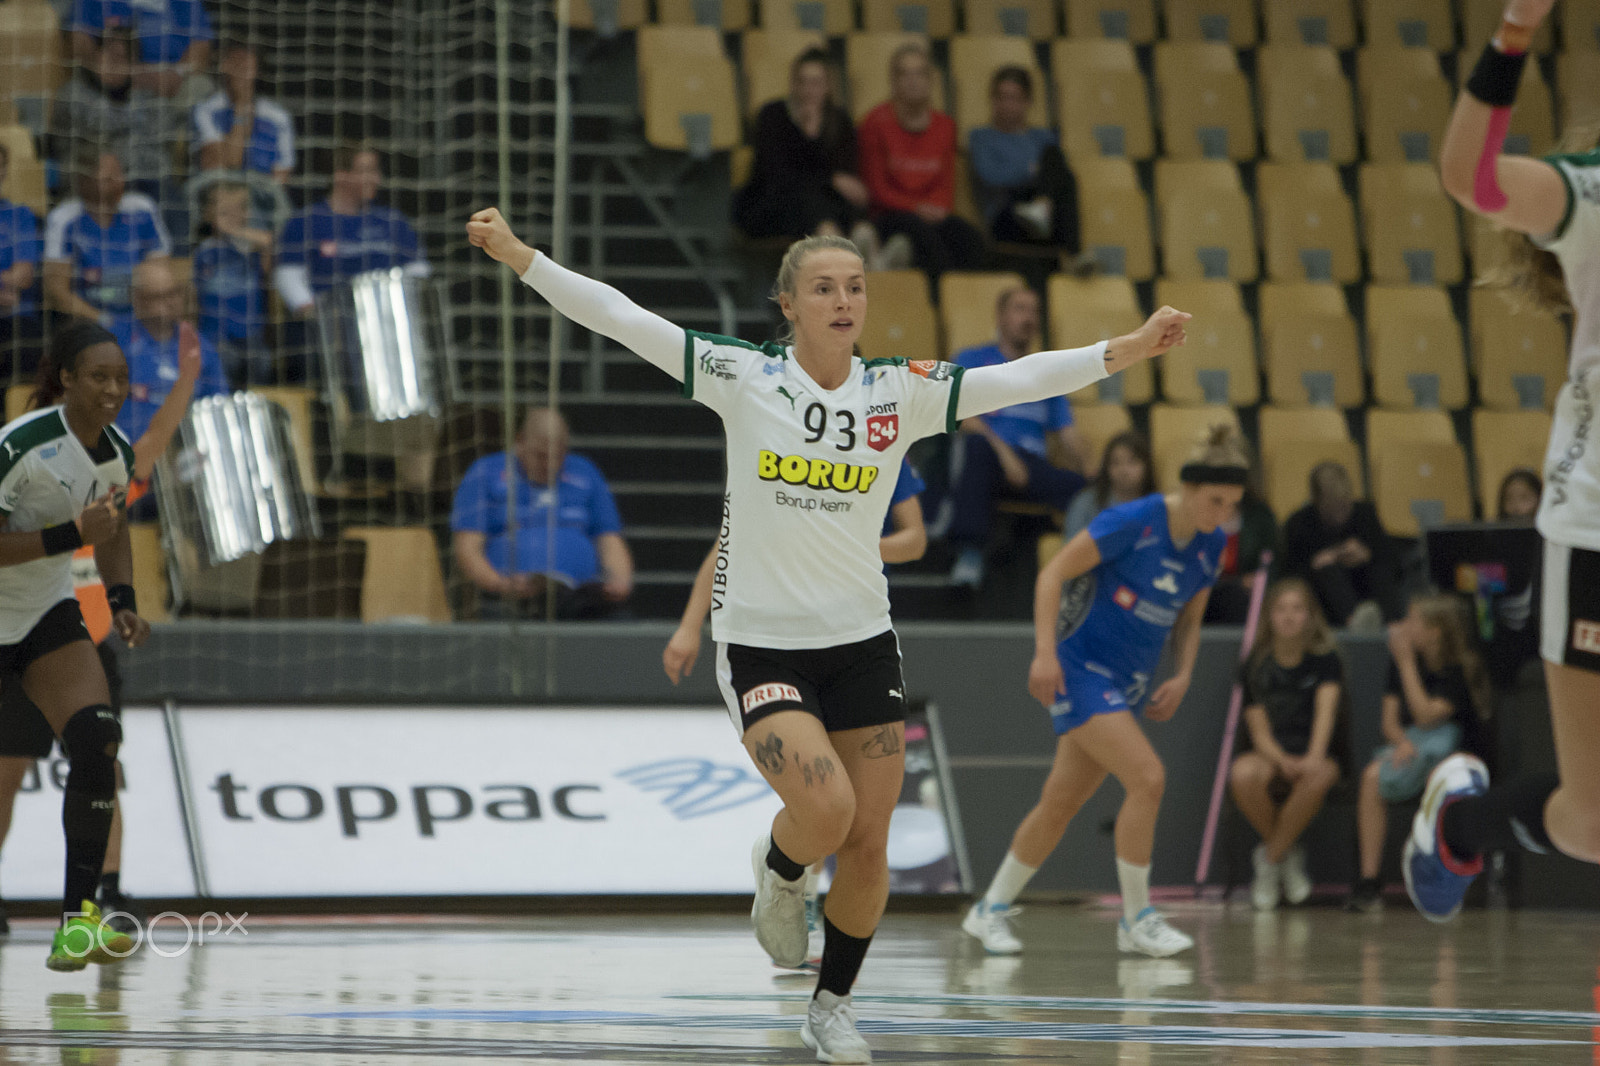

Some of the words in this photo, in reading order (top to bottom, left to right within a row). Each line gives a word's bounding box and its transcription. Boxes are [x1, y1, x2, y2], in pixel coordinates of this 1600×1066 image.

[804, 402, 855, 451] 93
[870, 420, 896, 442] 24
[758, 449, 879, 494] BORUP
[776, 491, 816, 512] Borup
[820, 498, 853, 512] kemi
[746, 686, 797, 708] FREJA
[209, 772, 608, 839] toppac
